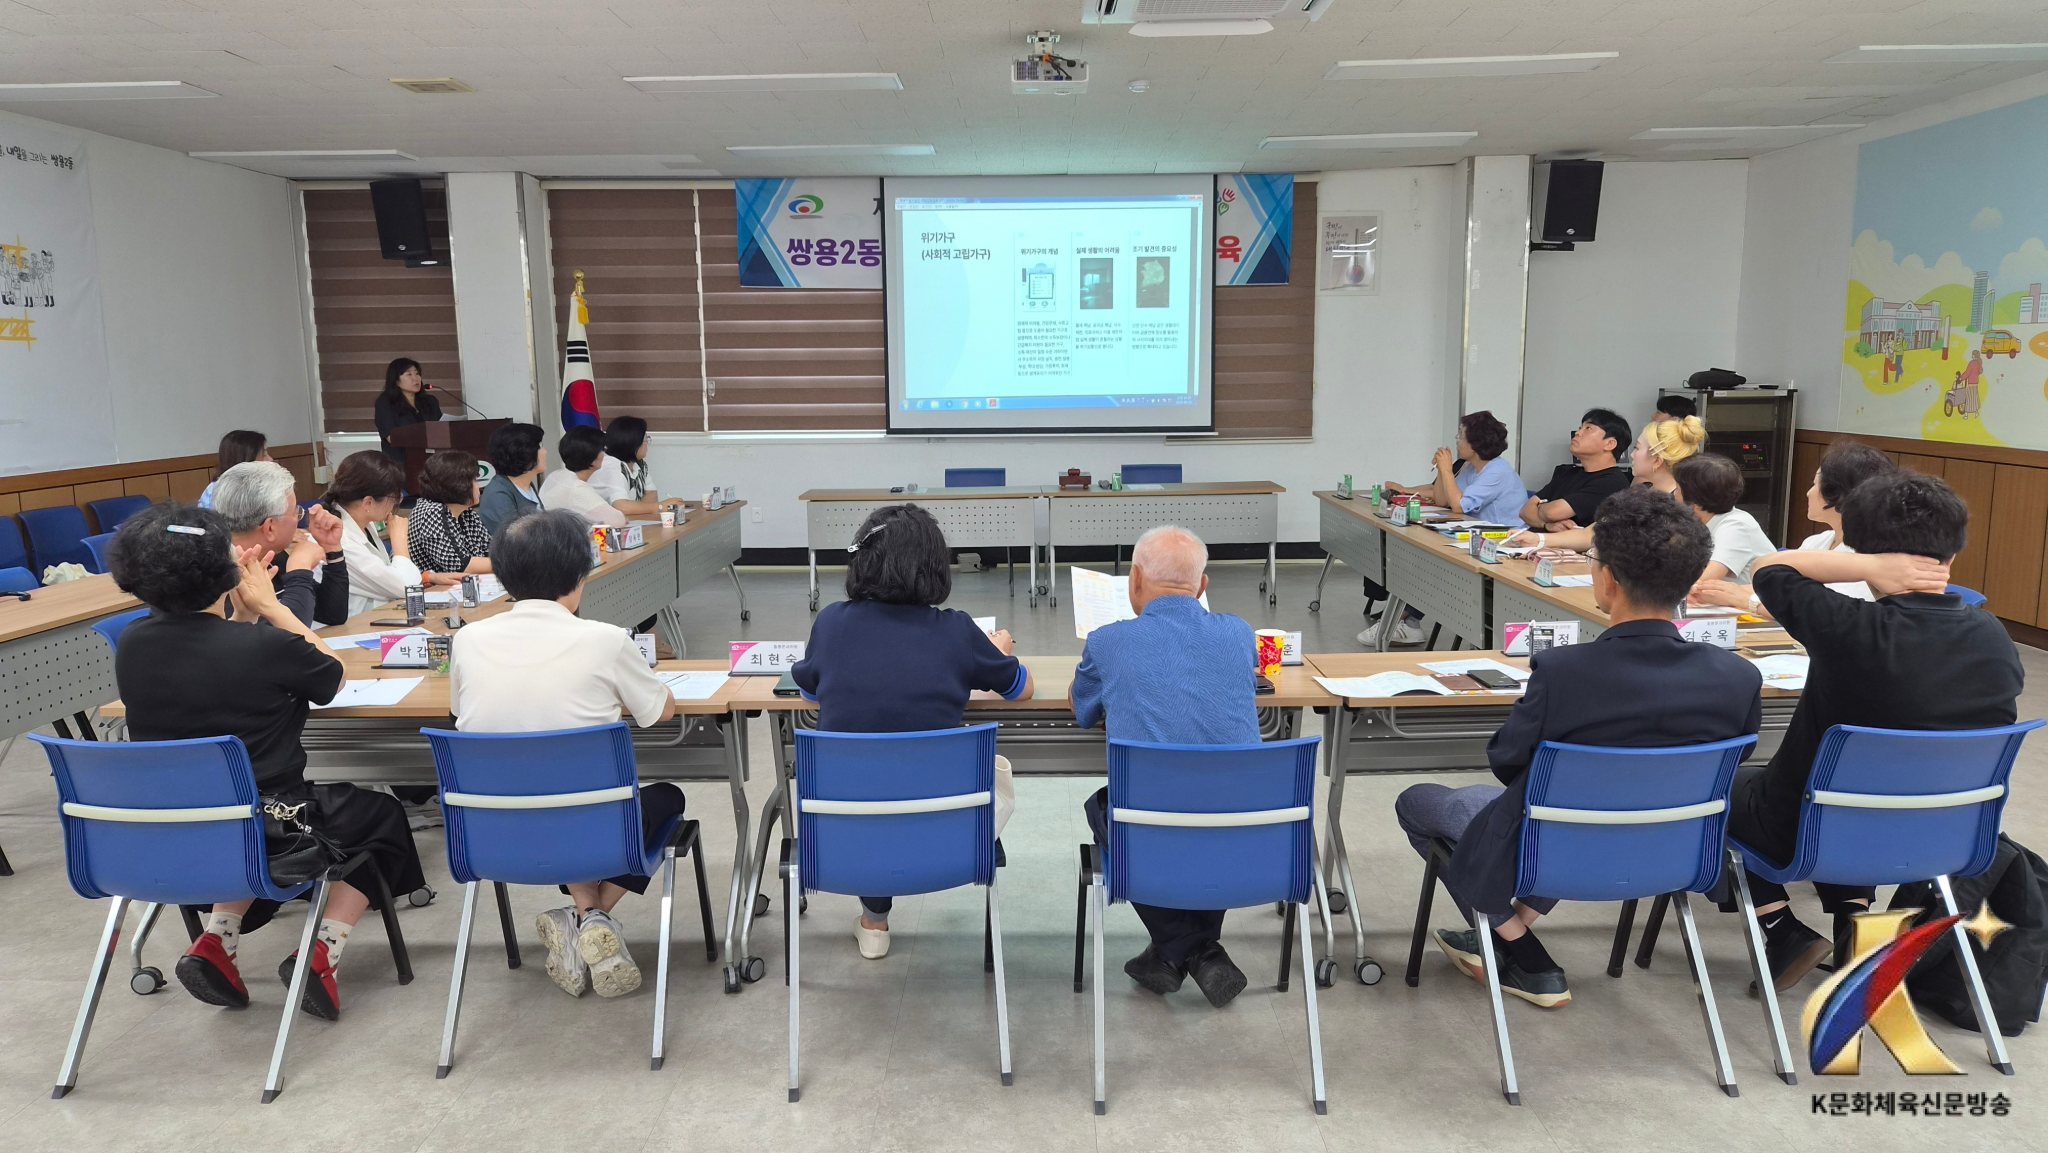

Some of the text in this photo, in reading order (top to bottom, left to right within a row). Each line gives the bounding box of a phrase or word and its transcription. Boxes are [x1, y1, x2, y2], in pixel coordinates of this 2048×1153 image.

[50, 154, 75, 170] 쌍용2동
[921, 232, 955, 243] 위기가구
[787, 238, 882, 267] 쌍용2동
[921, 248, 991, 261] (사회적 고립가구)
